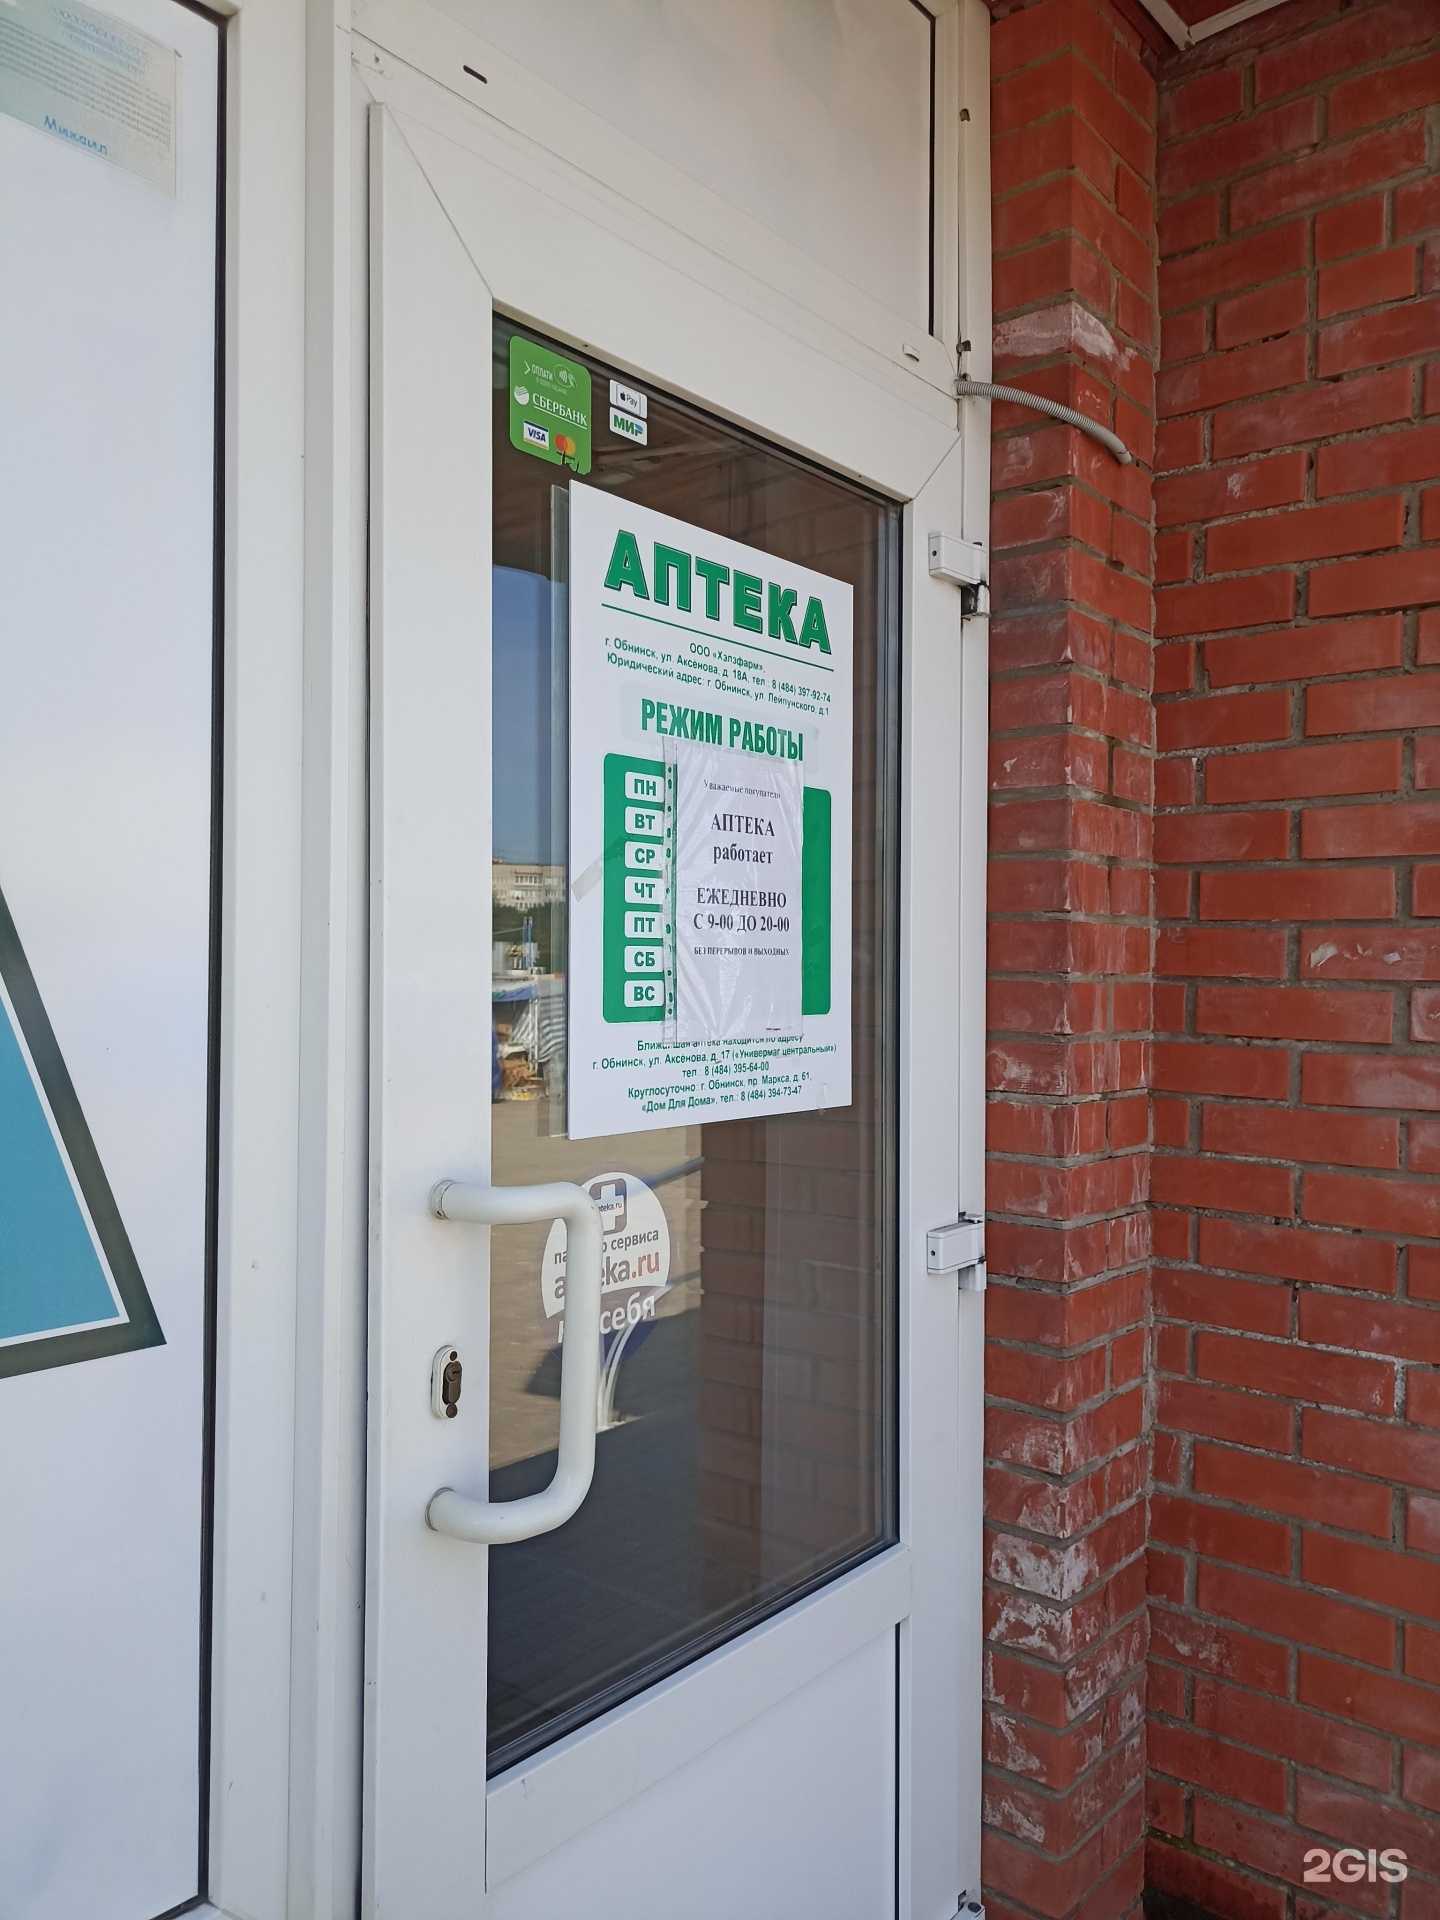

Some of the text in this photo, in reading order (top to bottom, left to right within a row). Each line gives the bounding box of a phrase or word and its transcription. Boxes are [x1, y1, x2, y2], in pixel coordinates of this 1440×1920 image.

[532, 392, 588, 426] СБЕРБАНК
[626, 394, 638, 408] Pay
[527, 427, 546, 443] VISA
[613, 415, 644, 437] МИР
[603, 529, 832, 655] АПТЕКА
[689, 643, 711, 657] ООО
[607, 652, 674, 678] Юридический
[771, 679, 777, 690] 8
[778, 680, 796, 695] (484)
[798, 686, 831, 703] 397-92-74
[641, 698, 803, 761] РЕЖИМ РАБОТЫ
[634, 778, 656, 797] ПН
[634, 813, 656, 830] ВТ
[711, 813, 775, 837] АПТЕКА
[634, 848, 656, 864] СР
[713, 843, 773, 864] работает
[634, 882, 656, 899] ЧТ
[697, 887, 787, 908] ЕЖЕДНЕВНО
[633, 917, 656, 933] ПТ
[693, 913, 790, 933] С 9-00 ДО 20-00
[633, 951, 656, 967] СБ
[694, 946, 706, 955] БЕЗ
[633, 986, 656, 1002] ВС
[721, 1050, 730, 1060] 17
[704, 1066, 710, 1076] 8
[711, 1065, 731, 1077] (484)
[733, 1061, 769, 1074] 395-64-00
[642, 1100, 666, 1113] «Дом
[668, 1098, 686, 1110] Для
[740, 1091, 746, 1102] 8
[747, 1089, 766, 1102] (484)
[768, 1085, 802, 1098] 394-73-47
[611, 1229, 659, 1251] сервиса
[600, 1291, 656, 1335] себя
